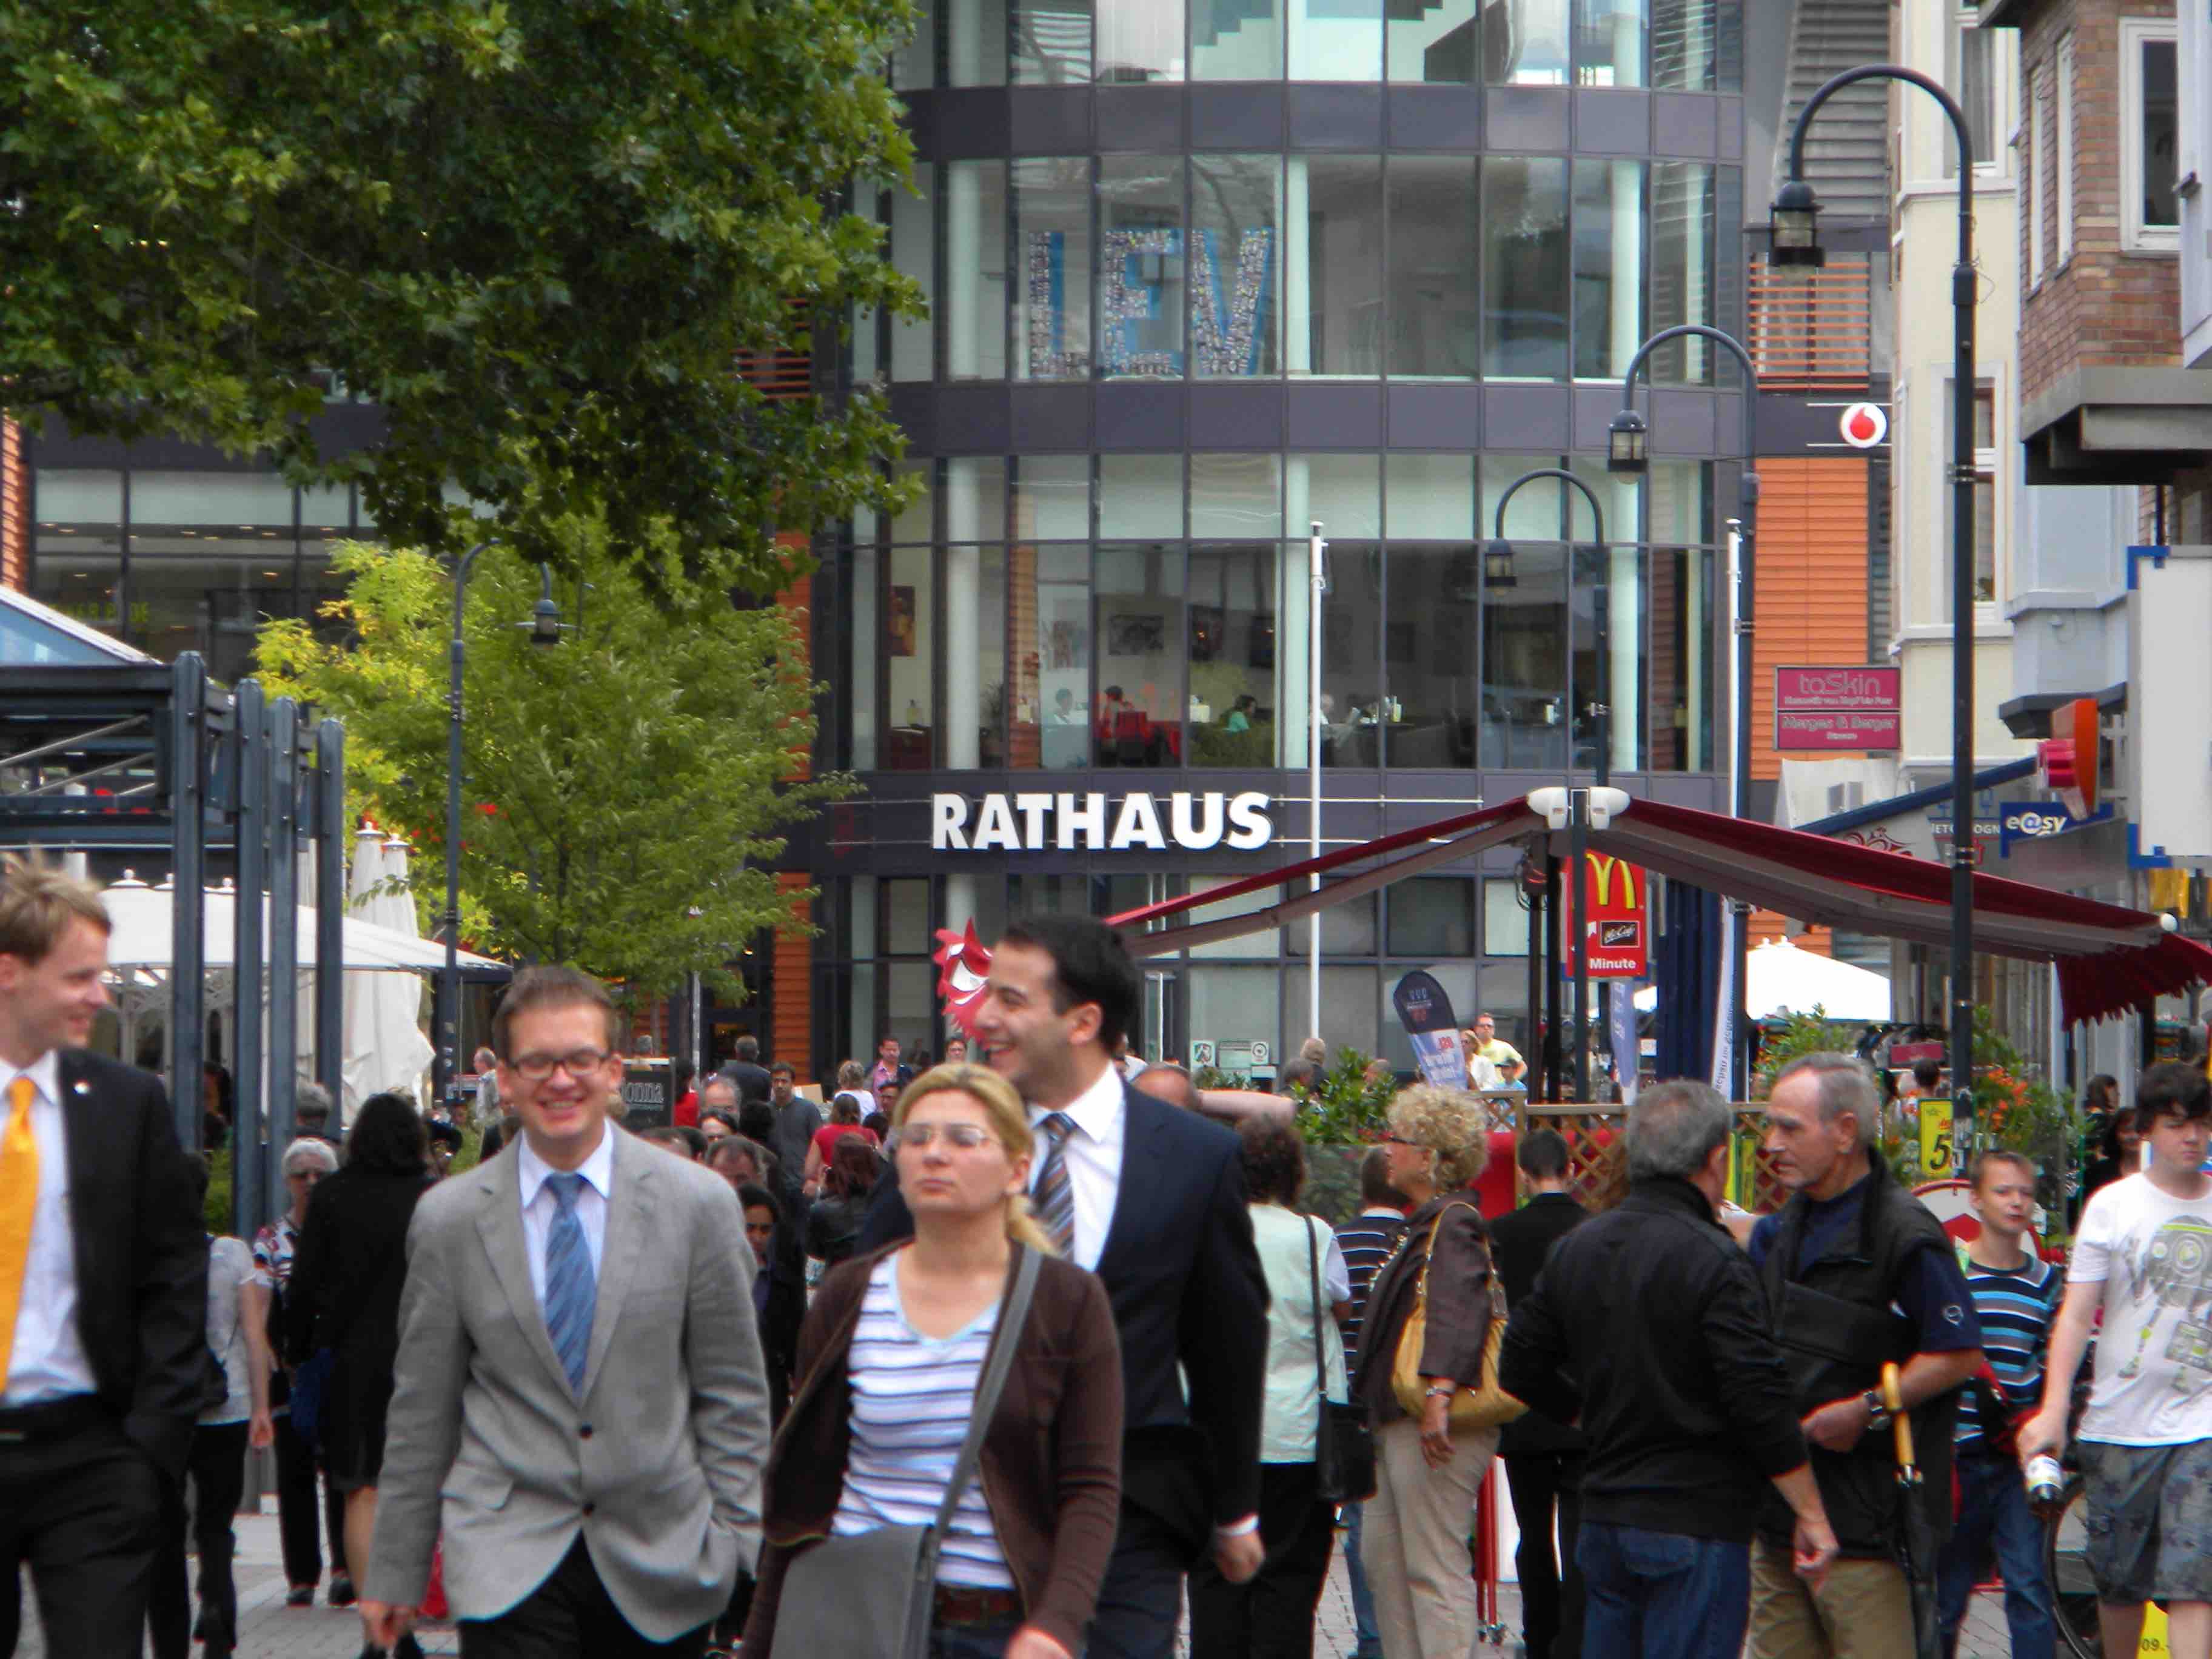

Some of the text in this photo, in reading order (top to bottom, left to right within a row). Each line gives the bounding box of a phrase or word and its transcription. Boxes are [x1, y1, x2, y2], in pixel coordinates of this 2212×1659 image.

[1029, 227, 1273, 376] LEV
[1798, 671, 1881, 694] toSkin
[932, 792, 1272, 850] RATHAUS
[1589, 958, 1637, 970] Minute
